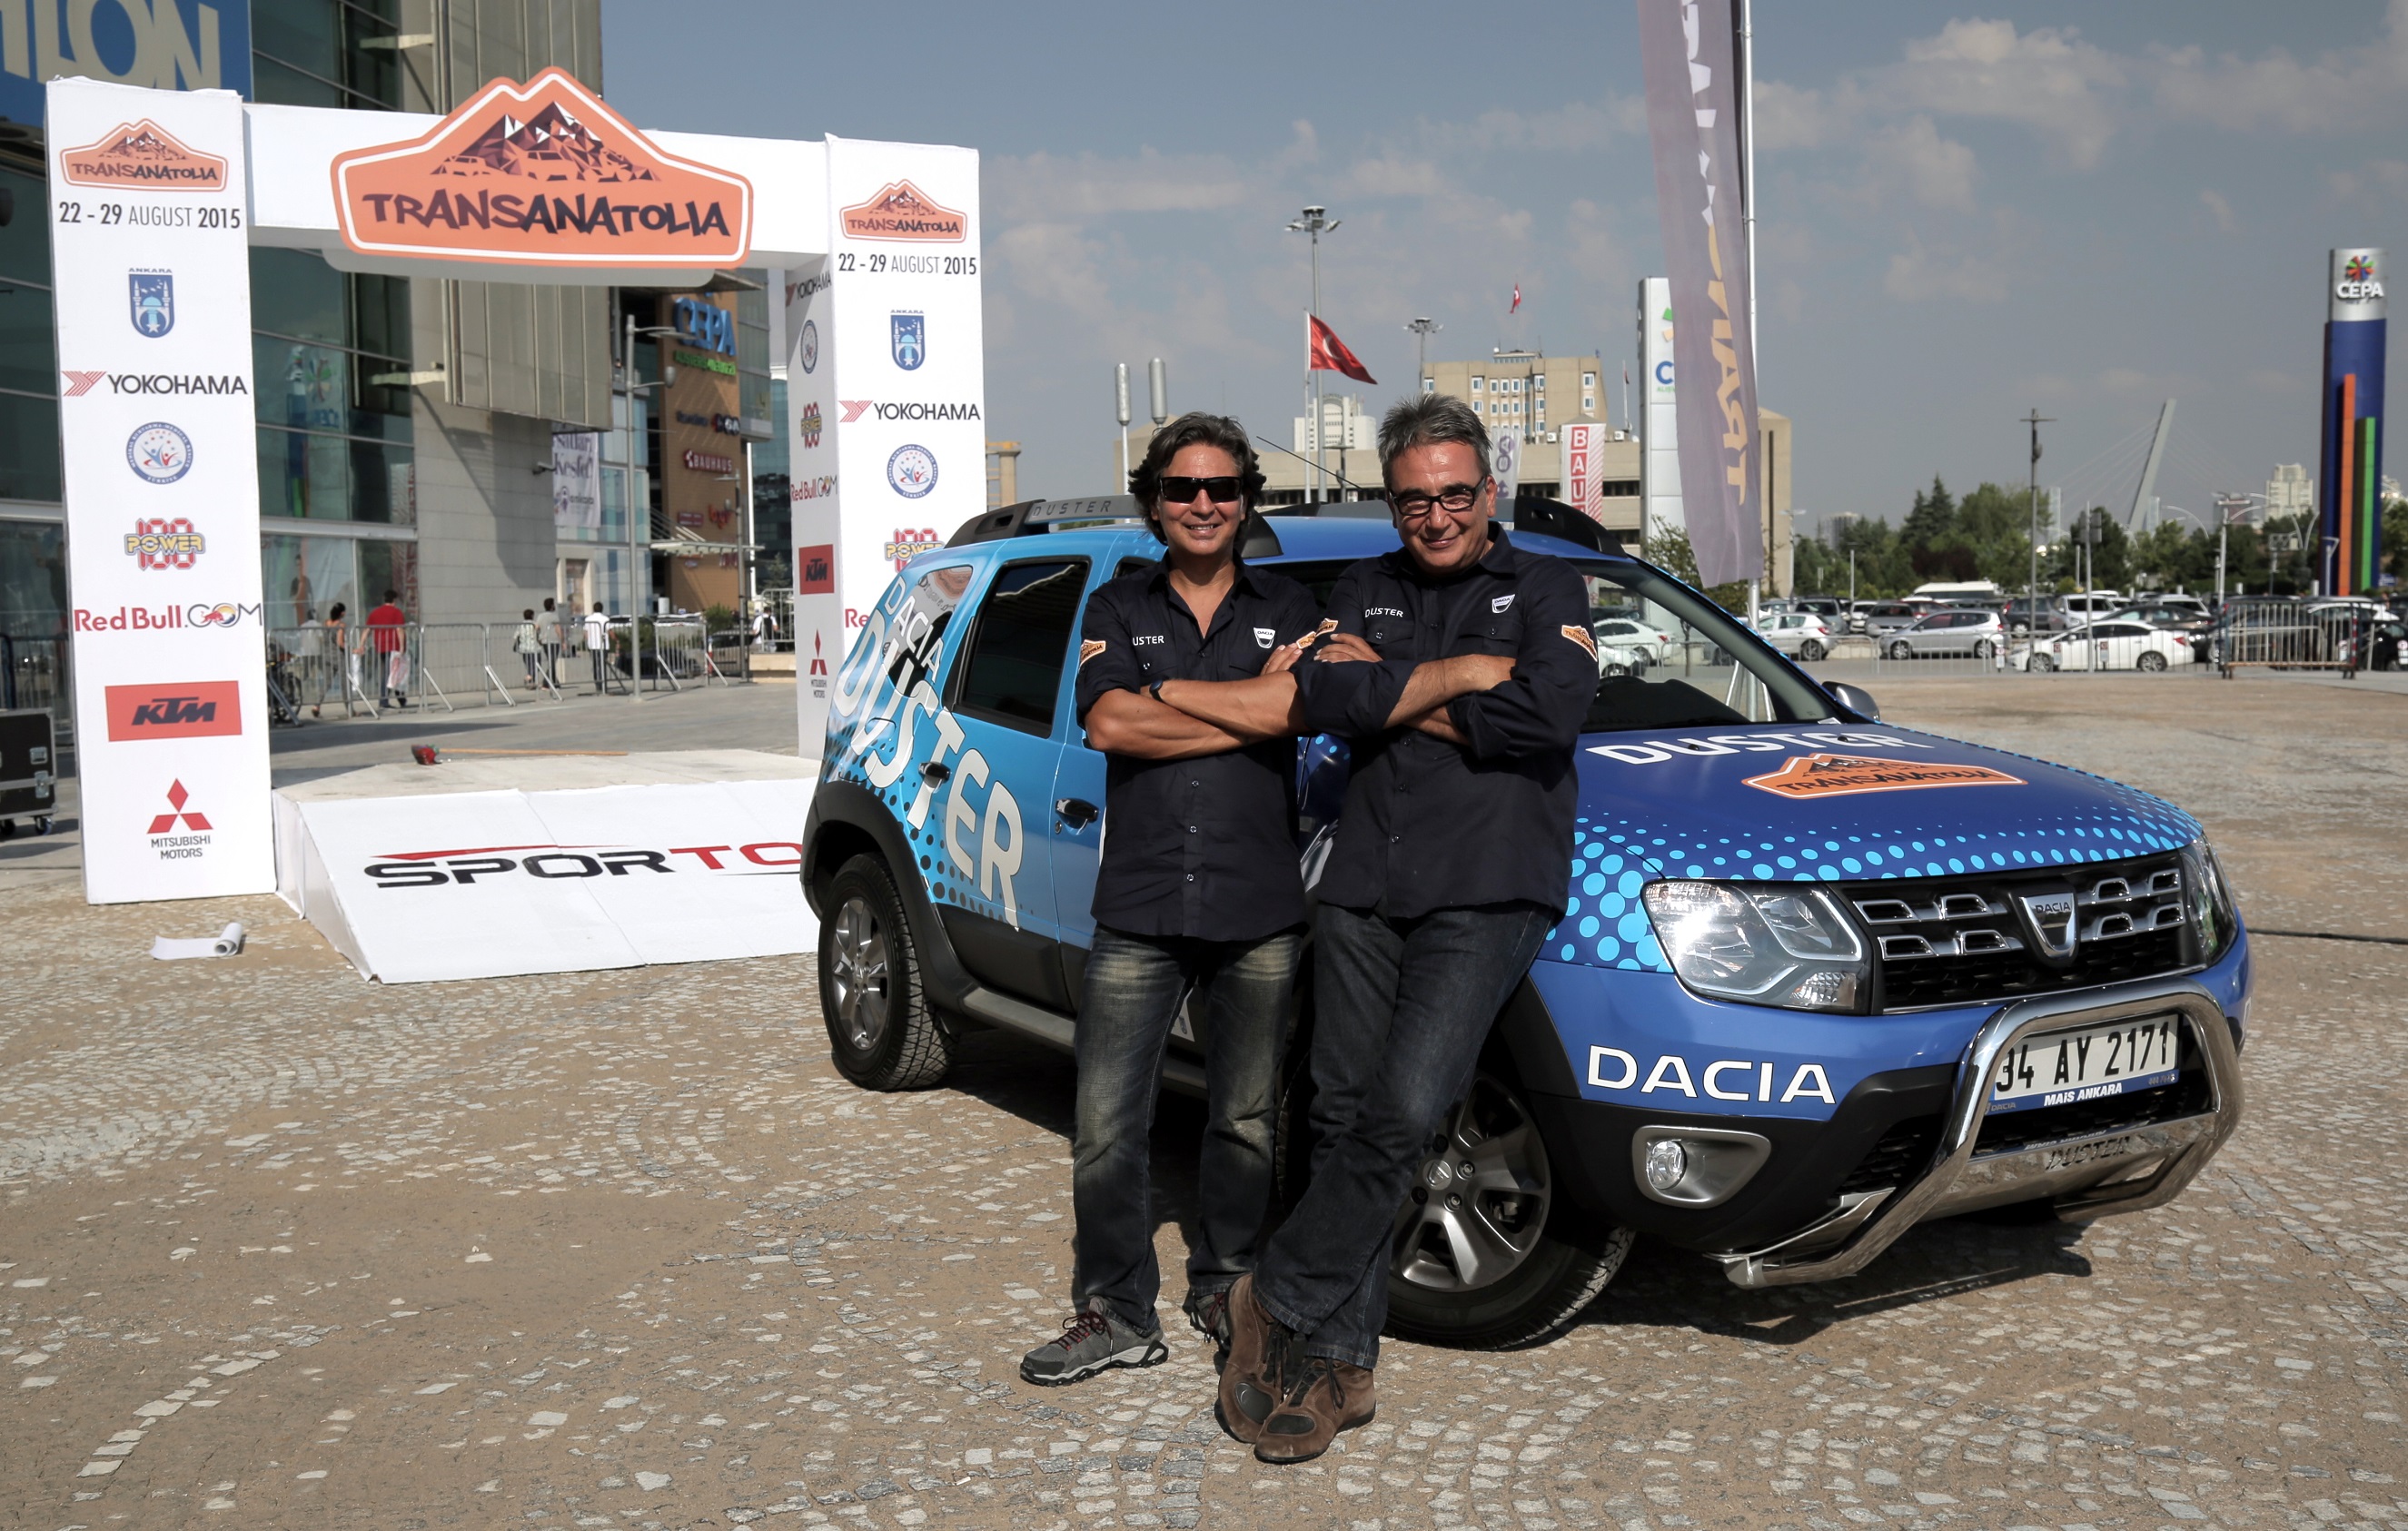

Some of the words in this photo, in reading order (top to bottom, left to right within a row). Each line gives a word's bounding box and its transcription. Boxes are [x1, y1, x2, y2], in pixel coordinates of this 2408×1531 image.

[72, 163, 218, 180] TRANSANATOLIA
[59, 202, 81, 222] 22
[100, 204, 122, 225] 29
[128, 206, 193, 227] AUGUST
[198, 208, 240, 228] 2015
[362, 188, 730, 237] TRANSANATOLIA
[848, 218, 960, 232] TRANSANATOLIA
[838, 253, 856, 272] 22
[869, 254, 887, 272] 29
[890, 255, 940, 273] AUGUST
[944, 257, 976, 274] 2015
[797, 271, 832, 301] YOKOHAMA
[2337, 282, 2384, 298] CEPA
[672, 297, 737, 357] CEPA
[107, 374, 248, 396] YOKOHAMA
[873, 402, 981, 421] YOKOHAMA
[1033, 500, 1112, 518] DUSTER
[126, 534, 203, 554] POWER
[806, 558, 827, 581] KTM
[74, 607, 126, 632] Red
[845, 607, 871, 628] Re
[1364, 607, 1403, 617] DUSTER
[884, 576, 945, 683] DACIA
[1132, 636, 1164, 646] USTER
[131, 696, 217, 726] KTM
[1585, 732, 1936, 766] DUSTER
[832, 609, 1024, 931] DUSTER
[1776, 770, 2002, 791] TRANSANATOLIA
[151, 835, 211, 848] MITSUBISHI
[160, 847, 203, 860] MOTORS
[363, 843, 802, 888] SPORTO
[2036, 901, 2073, 914] DACIA
[1996, 1044, 2035, 1091] 34
[2053, 1035, 2092, 1085] AY
[2105, 1022, 2169, 1077] 2171
[1587, 1044, 1838, 1105] DACIA
[2076, 1082, 2123, 1101] ANKARA
[1991, 1101, 2017, 1111] DACIA
[2045, 1136, 2131, 1170] DUSTER
